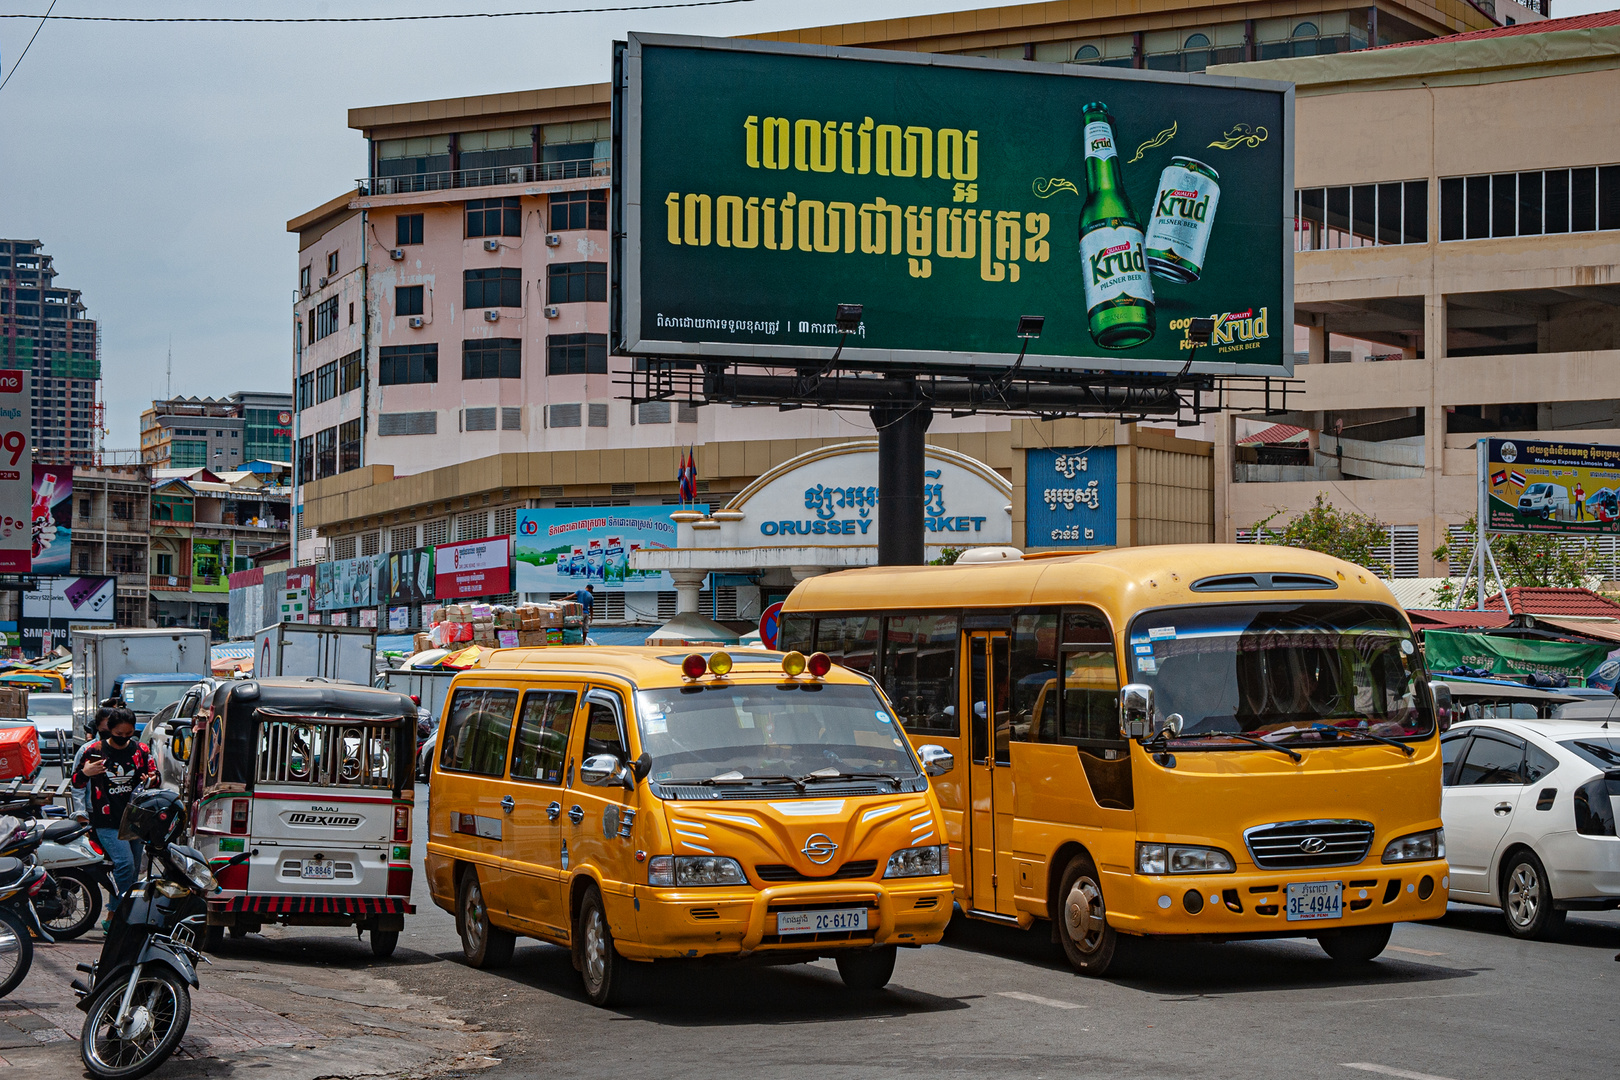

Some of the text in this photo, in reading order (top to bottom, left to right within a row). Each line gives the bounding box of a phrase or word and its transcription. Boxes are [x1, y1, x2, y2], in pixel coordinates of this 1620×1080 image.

[744, 115, 978, 203] ពេលវេលាល្អ
[1155, 189, 1210, 223] Krud
[1183, 221, 1198, 229] BEER
[1106, 244, 1128, 254] QUALITY
[1089, 242, 1147, 286] Krud
[1100, 276, 1126, 291] PILSNER
[1229, 312, 1251, 320] QUALITY
[1169, 318, 1193, 330] GOO
[1211, 307, 1269, 346] Krud
[1218, 343, 1244, 353] PILSNER
[1245, 341, 1261, 350] BEER
[0, 431, 26, 466] 9
[654, 522, 675, 533] 100%
[760, 516, 987, 535] ORUSSEY RKET
[1084, 526, 1094, 540] ២
[108, 785, 132, 794] adidas
[289, 813, 360, 826] Maxima
[1290, 895, 1339, 914] 3E-4944
[816, 913, 860, 929] 2C-6179
